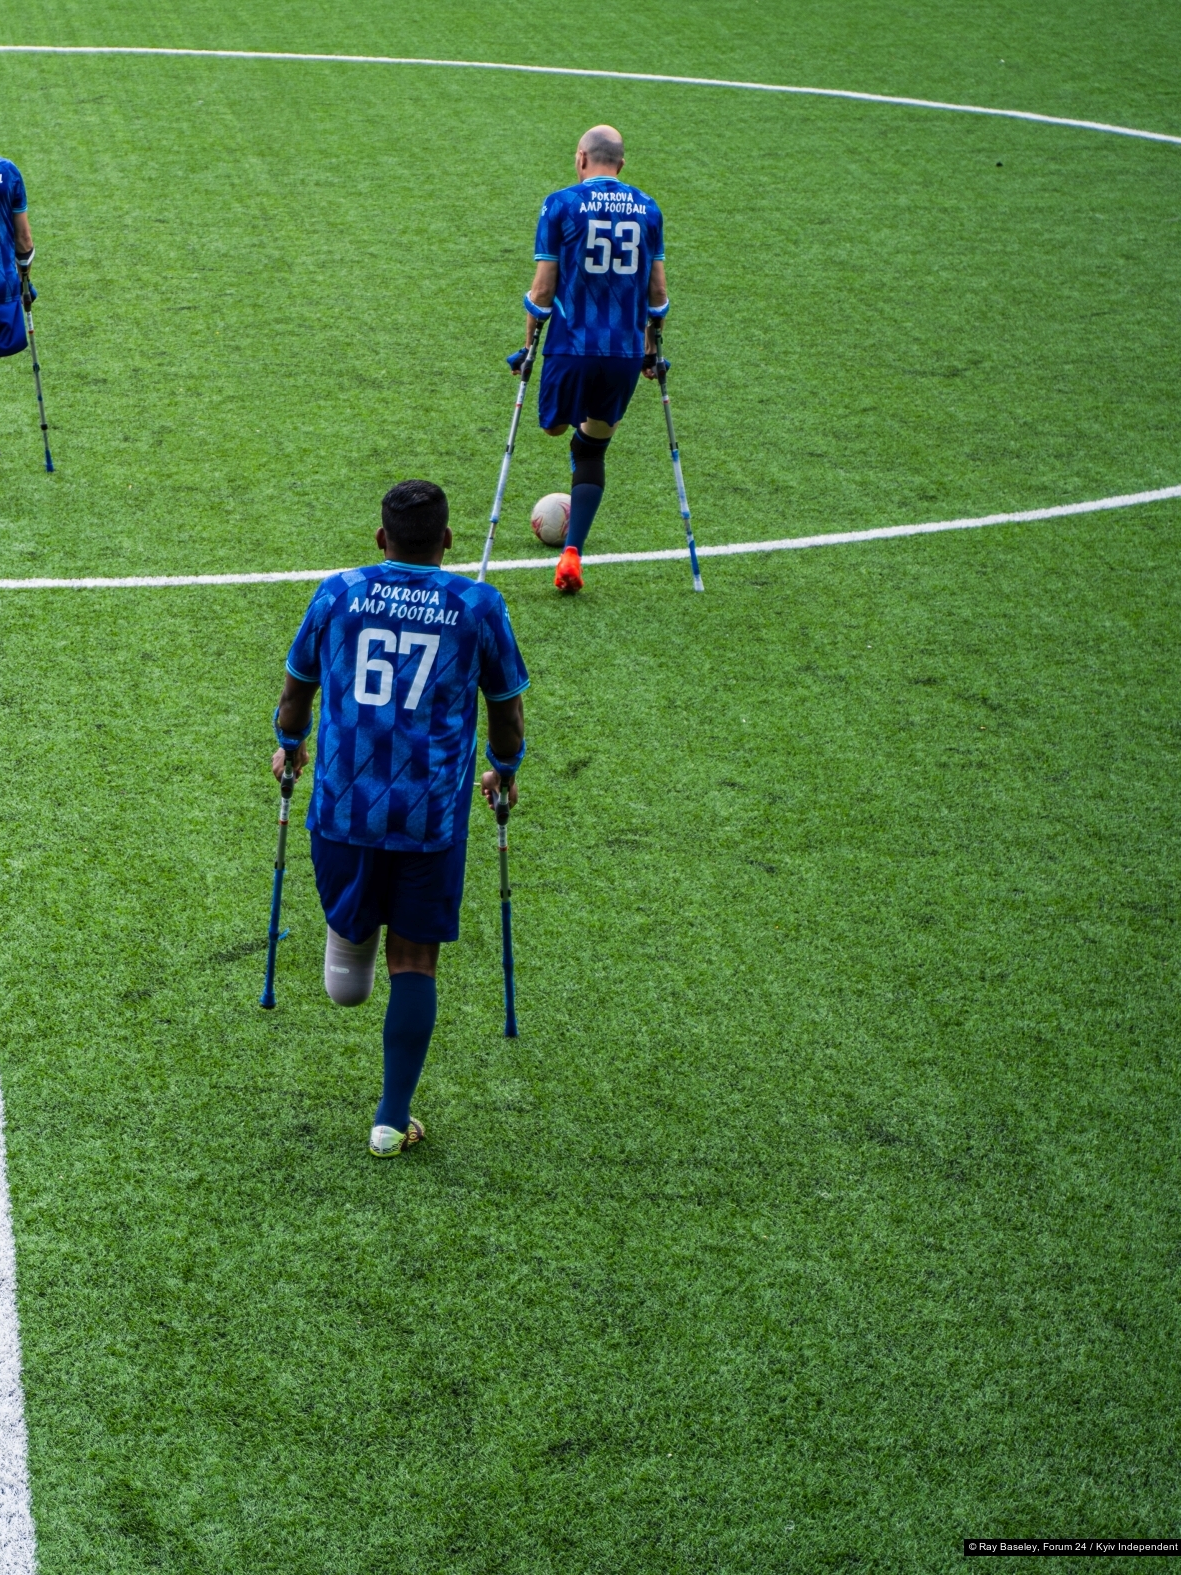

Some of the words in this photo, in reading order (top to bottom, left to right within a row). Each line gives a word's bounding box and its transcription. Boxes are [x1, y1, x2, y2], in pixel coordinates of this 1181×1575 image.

[579, 202, 602, 213] AMP
[604, 202, 647, 215] FOOTBALL
[591, 191, 634, 203] POKROVA
[584, 219, 641, 275] 53
[371, 583, 440, 606] POKROVA
[349, 597, 386, 615] AMP
[389, 603, 460, 626] FOOTBALL
[354, 627, 441, 711] 67
